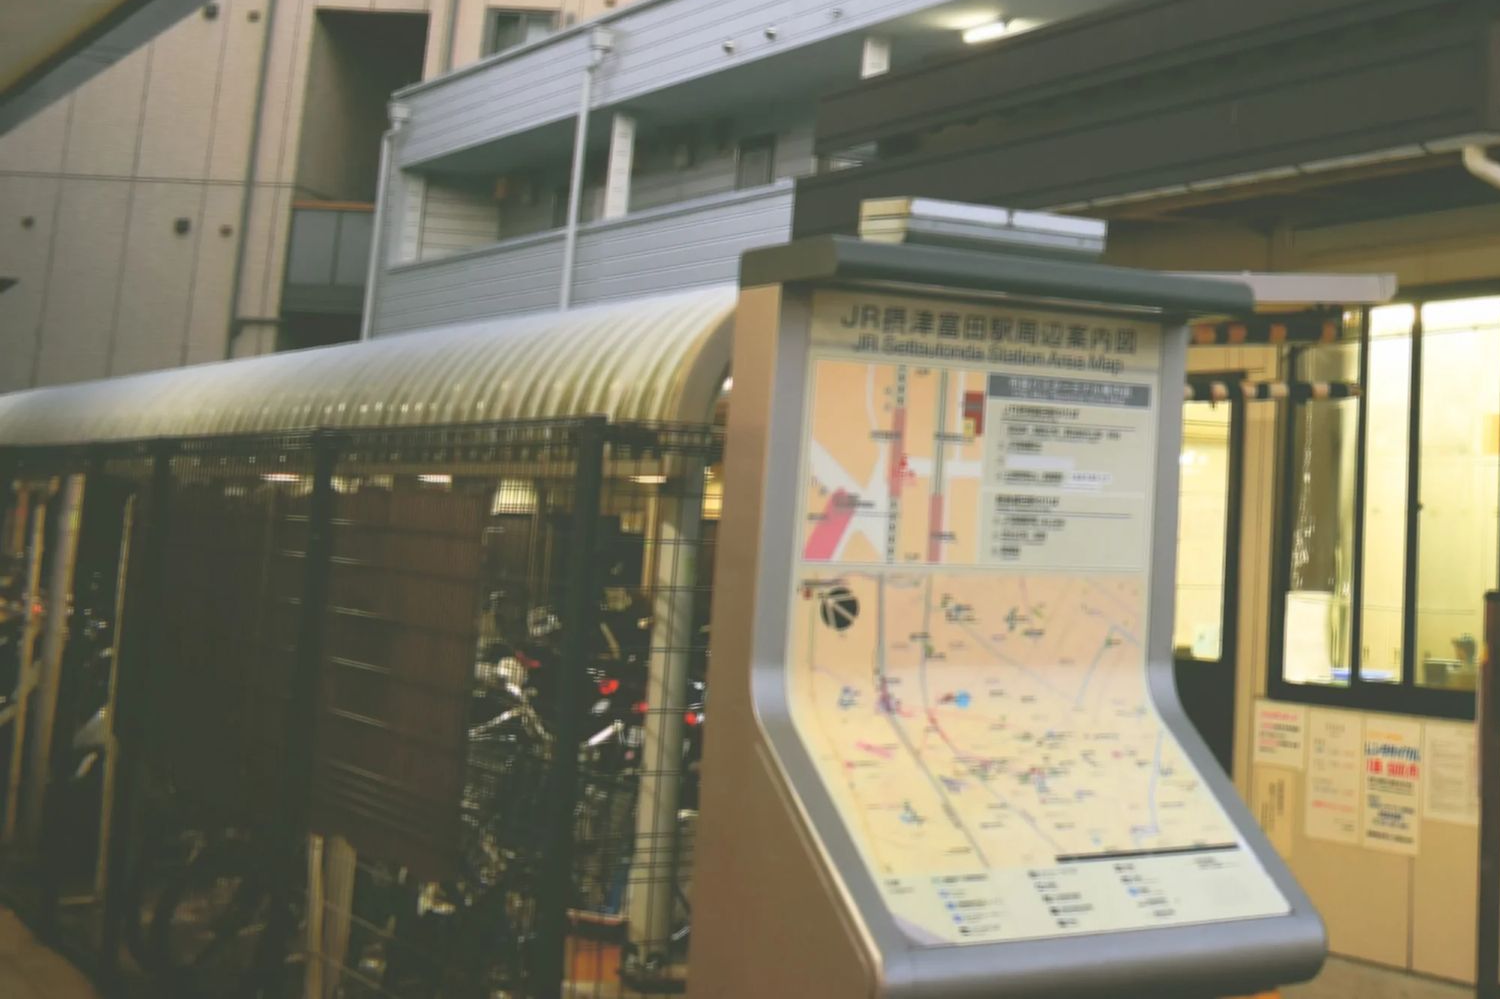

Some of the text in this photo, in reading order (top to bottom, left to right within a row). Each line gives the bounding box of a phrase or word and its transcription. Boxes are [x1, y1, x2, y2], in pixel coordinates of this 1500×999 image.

[840, 304, 1139, 354] JR摂津富田駅周辺案内図
[987, 342, 1046, 367] Station
[1086, 355, 1125, 375] Map
